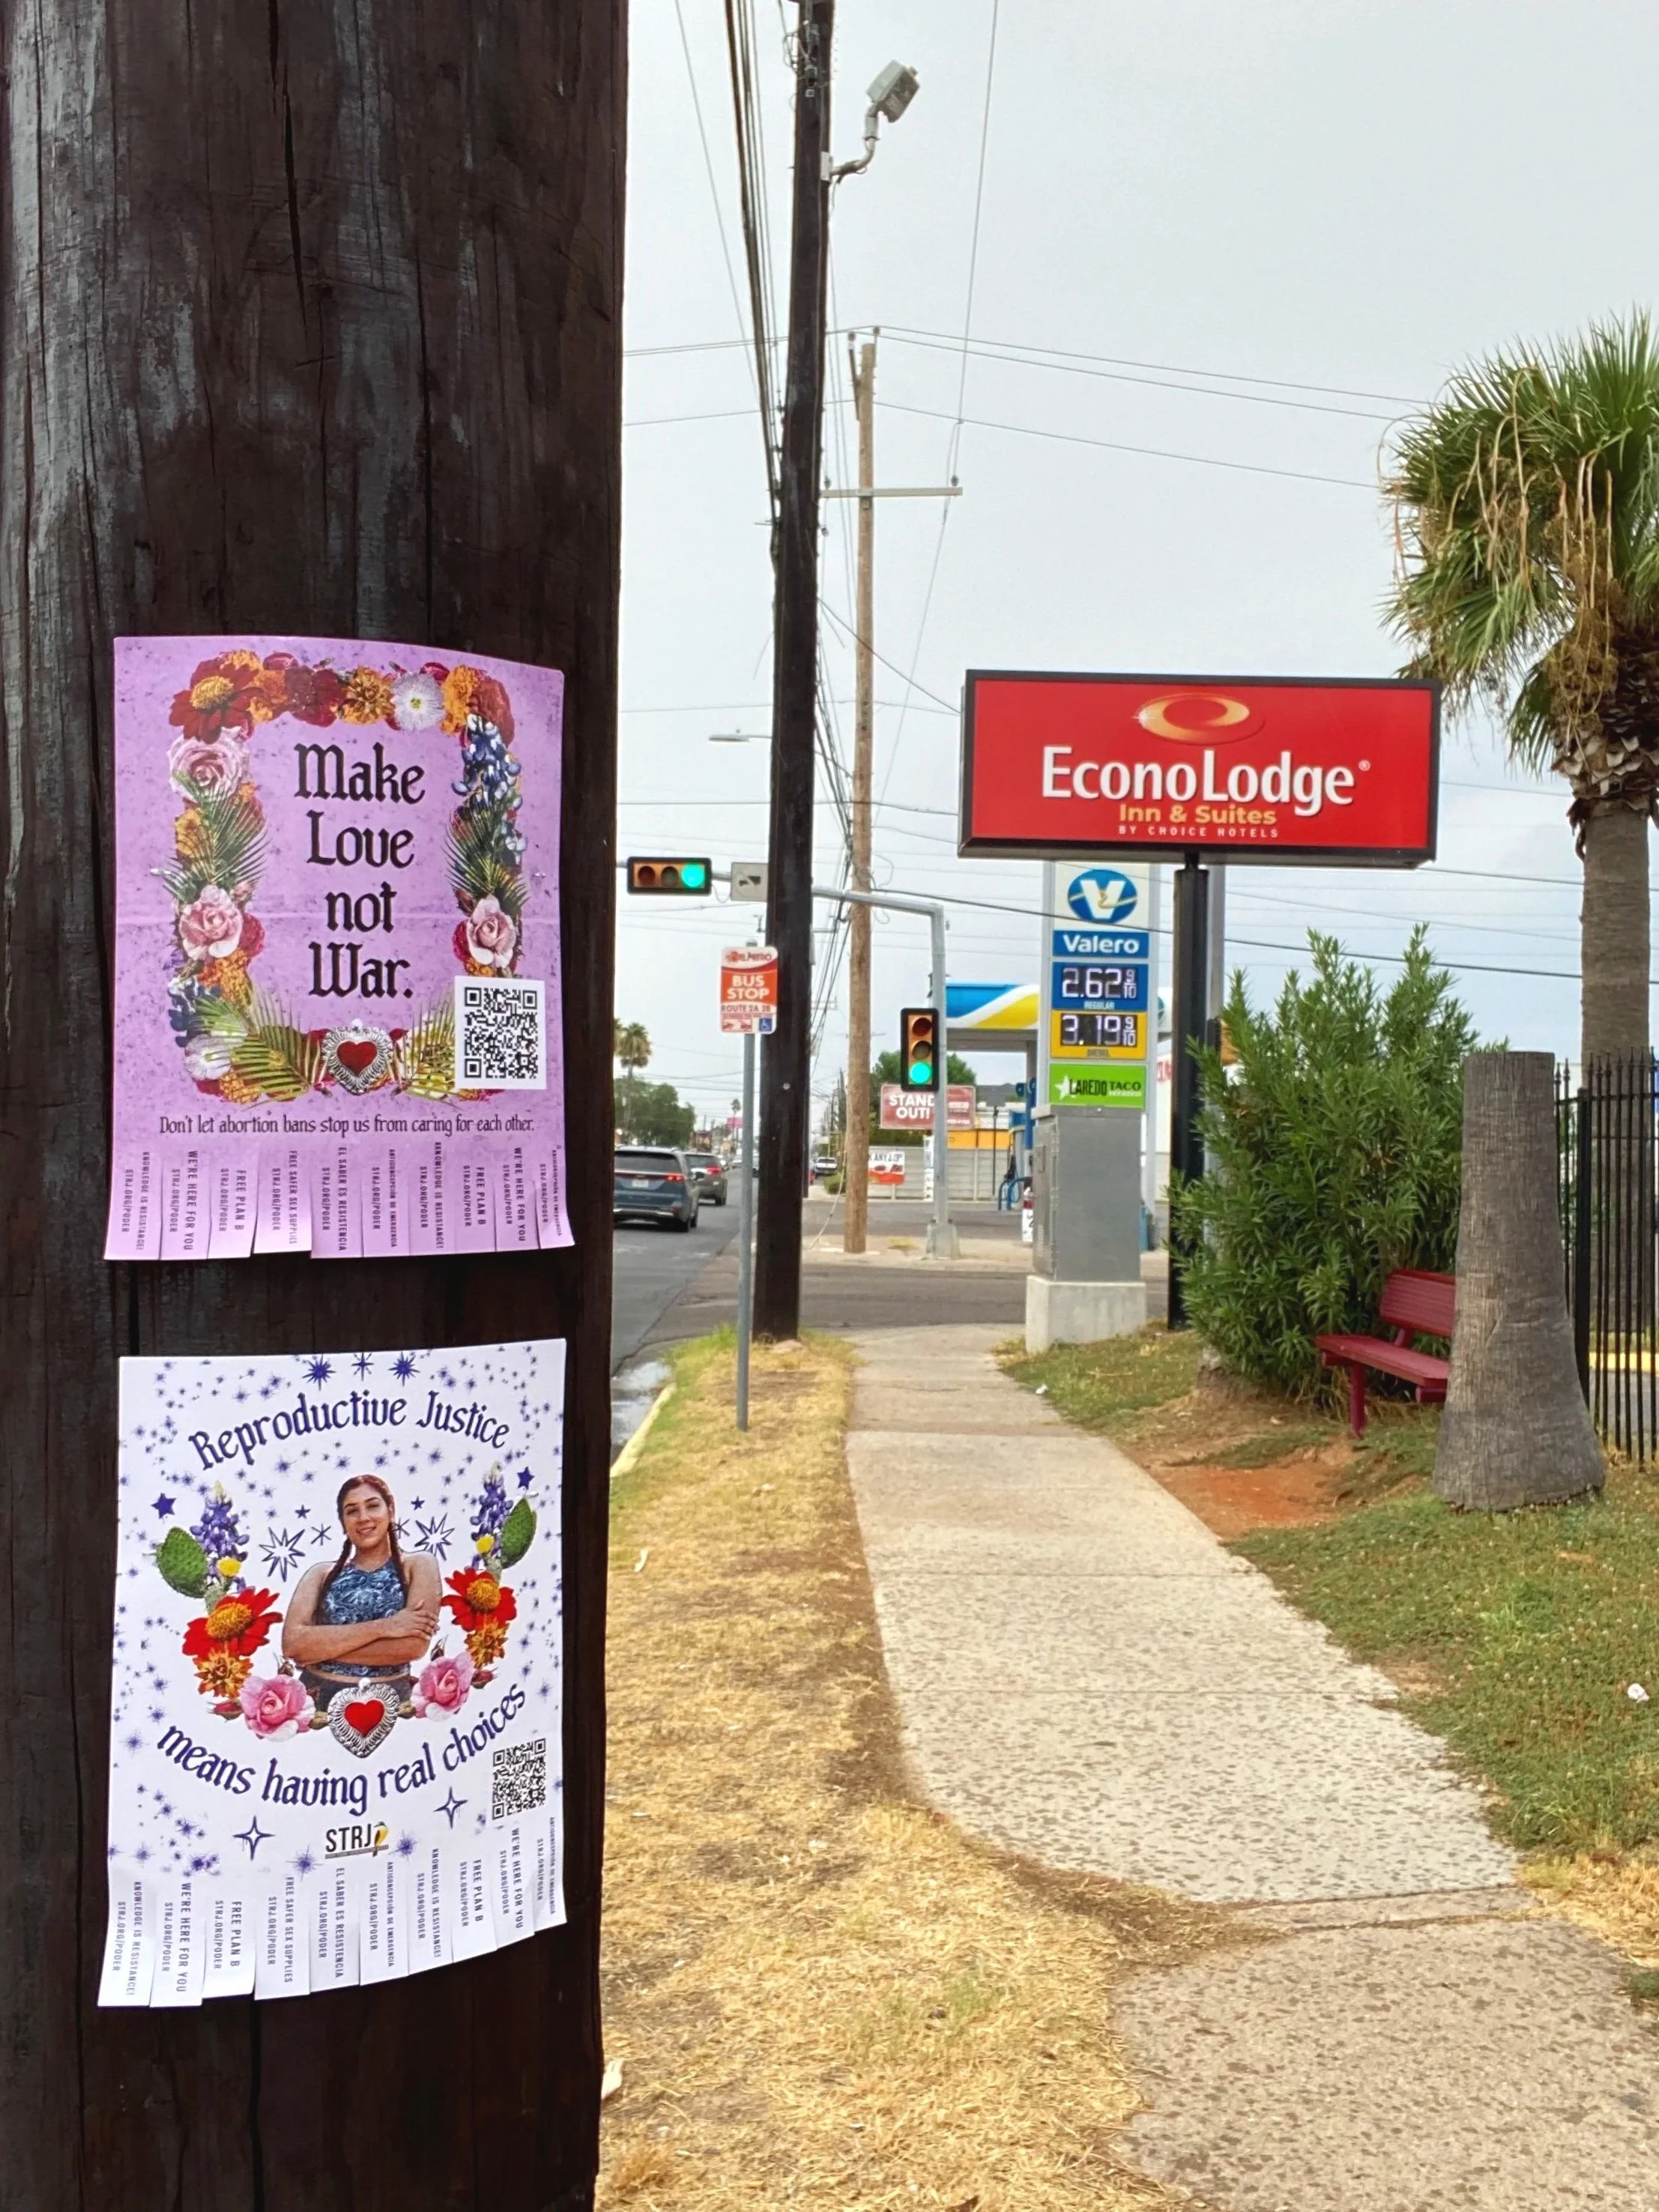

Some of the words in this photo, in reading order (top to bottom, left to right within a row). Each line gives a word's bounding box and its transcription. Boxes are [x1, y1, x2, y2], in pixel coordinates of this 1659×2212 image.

[294, 743, 425, 804] Make
[1042, 745, 1355, 816] EconoLodge
[1119, 804, 1161, 823] Inn
[1169, 805, 1188, 824] &
[1195, 804, 1277, 825] Suites
[307, 811, 414, 868] Love
[1118, 826, 1137, 835] BY
[1148, 827, 1207, 837] CHOICE
[1217, 827, 1279, 838] HOTELS
[325, 882, 397, 933] not
[1063, 934, 1140, 954] Valero
[308, 942, 414, 999] War.
[732, 974, 764, 987] BUS
[727, 988, 770, 1000] STOP
[1062, 967, 1121, 999] 2.62
[1062, 1015, 1121, 1045] 3.19
[1069, 1079, 1107, 1096] LAREDO
[1107, 1081, 1142, 1091] TACO
[896, 1107, 930, 1119] OUT!
[160, 1116, 193, 1133] Don't
[198, 1115, 215, 1133] let
[219, 1115, 279, 1133] abortion
[283, 1115, 316, 1132] bans
[320, 1116, 349, 1137] stop
[354, 1119, 370, 1132] us
[374, 1114, 408, 1132] from
[411, 1115, 453, 1137] caring
[456, 1114, 474, 1131] for
[477, 1114, 501, 1131] each
[505, 1114, 534, 1131] other.
[338, 1147, 347, 1155] EL
[235, 1170, 247, 1192] FREE
[476, 1167, 485, 1188] FREE
[187, 1183, 197, 1206] HERE
[338, 1188, 347, 1197] ES
[516, 1178, 524, 1200] HERE
[235, 1197, 246, 1220] PLAN
[288, 1197, 297, 1211] SEX
[477, 1192, 486, 1215] PLAN
[185, 1211, 196, 1228] FOR
[184, 1233, 194, 1250] YOU
[189, 1388, 407, 1470] Reproductive
[416, 1390, 510, 1449] Justice
[157, 1725, 256, 1796] means
[262, 1758, 368, 1816] having
[379, 1742, 435, 1798] real
[443, 1683, 527, 1771] choices
[326, 1823, 372, 1852] STRJ
[336, 1867, 345, 1877] EL
[473, 1859, 482, 1883] FREE
[513, 1861, 522, 1885] HERE
[285, 1877, 294, 1896] FREE
[515, 1888, 523, 1907] FOR
[474, 1886, 483, 1911] PLAN
[231, 1901, 242, 1924] FREE
[285, 1899, 294, 1923] SAFER
[336, 1911, 344, 1920] ES
[515, 1909, 523, 1929] YOU
[180, 1918, 190, 1943] HERE
[285, 1927, 293, 1941] SEX
[231, 1930, 241, 1955] PLAN
[178, 1947, 189, 1967] FOR
[176, 1972, 187, 1992] YOU
